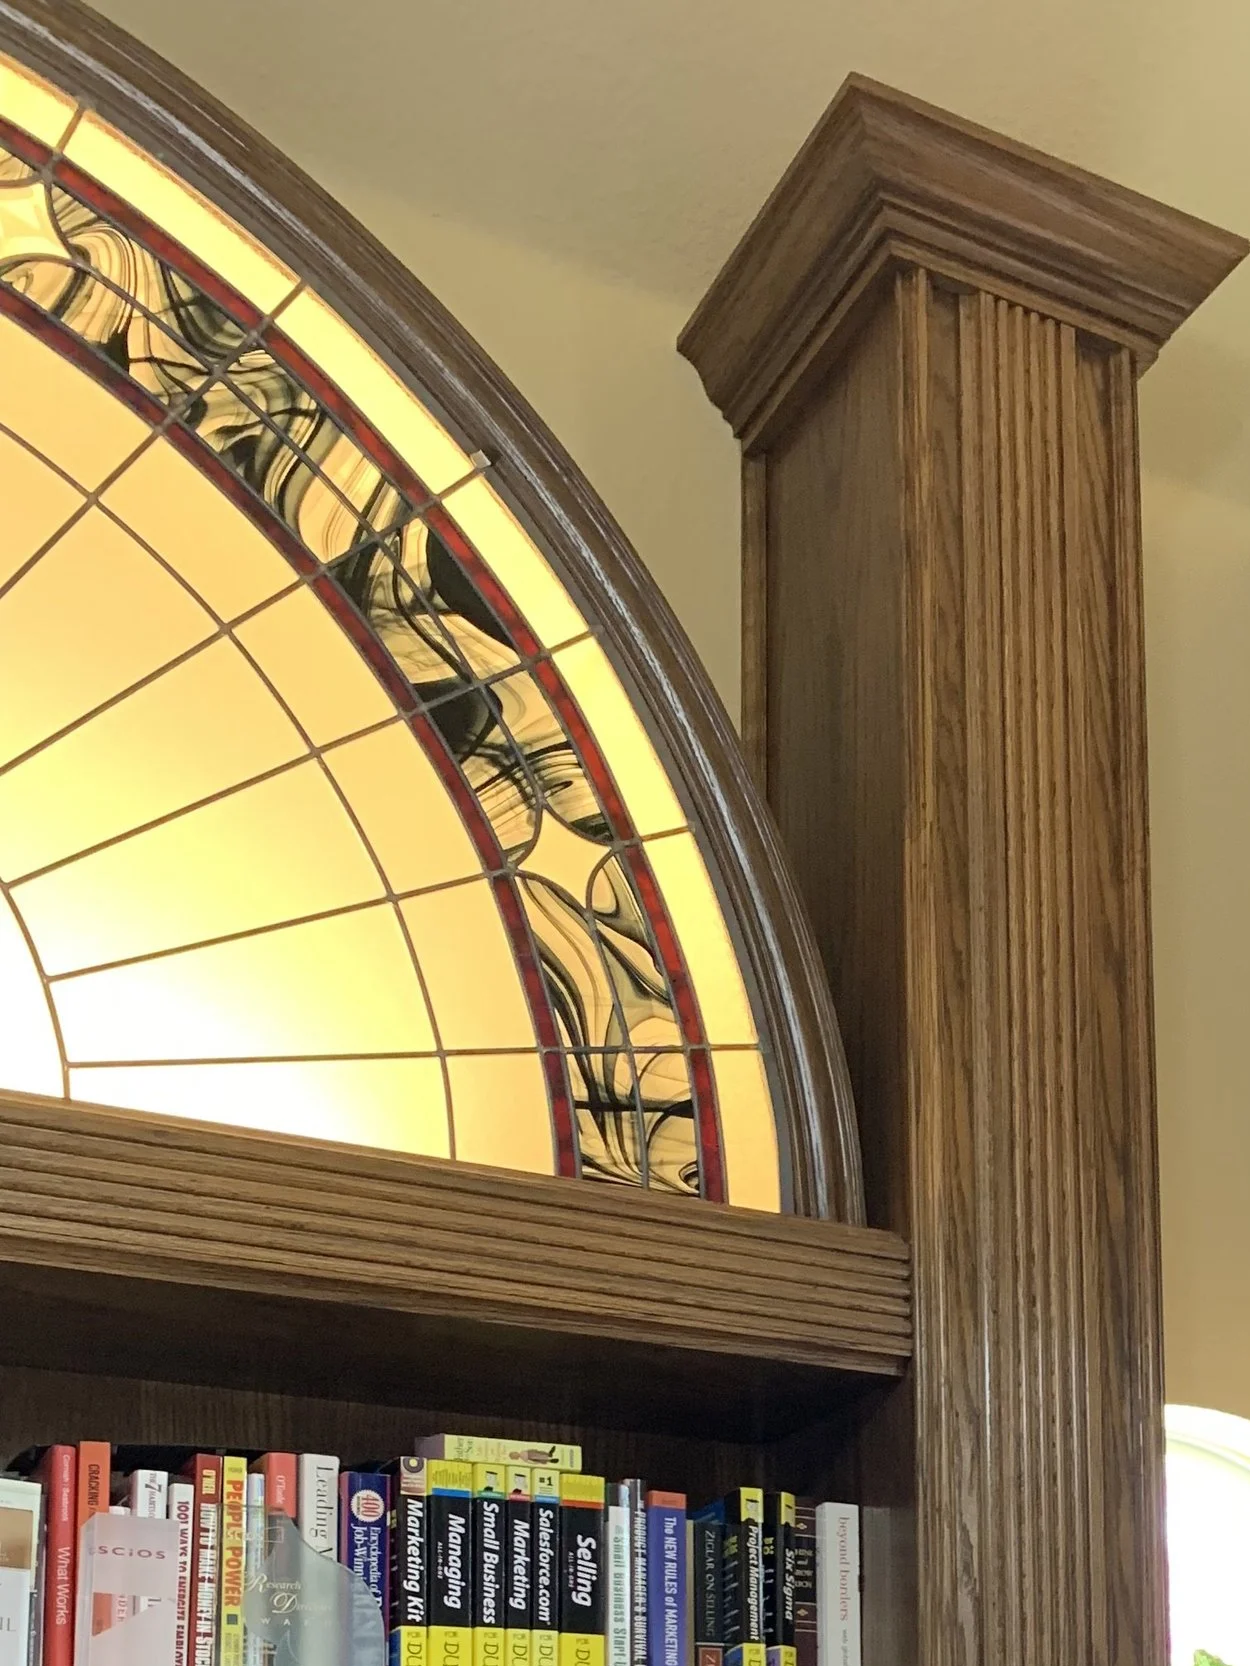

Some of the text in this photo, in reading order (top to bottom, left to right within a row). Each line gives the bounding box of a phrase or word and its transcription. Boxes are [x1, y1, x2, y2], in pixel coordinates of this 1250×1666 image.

[88, 1464, 100, 1506] CRACKING
[311, 1466, 334, 1538] Leading
[223, 1480, 246, 1606] PEOPLE POWER
[369, 1527, 383, 1593] Encyclopedia of
[404, 1500, 424, 1622] Marketing Kit
[444, 1514, 467, 1608] Managing
[634, 1511, 647, 1556] PRODUCT
[664, 1517, 677, 1534] The
[664, 1537, 677, 1559] NEW
[55, 1546, 70, 1625] What Works
[482, 1502, 500, 1624] Small Business
[509, 1520, 531, 1609] Marketing
[538, 1508, 554, 1622] Salesforce.com
[571, 1535, 597, 1606] Selling
[664, 1562, 677, 1594] RULES
[705, 1531, 717, 1636] ZIGLAR ON SELLING
[749, 1526, 761, 1641] Project Management
[836, 1517, 851, 1622] beyond borders
[635, 1616, 647, 1660] SURVIVAL
[664, 1597, 678, 1607] of
[664, 1609, 678, 1666] MARKETING
